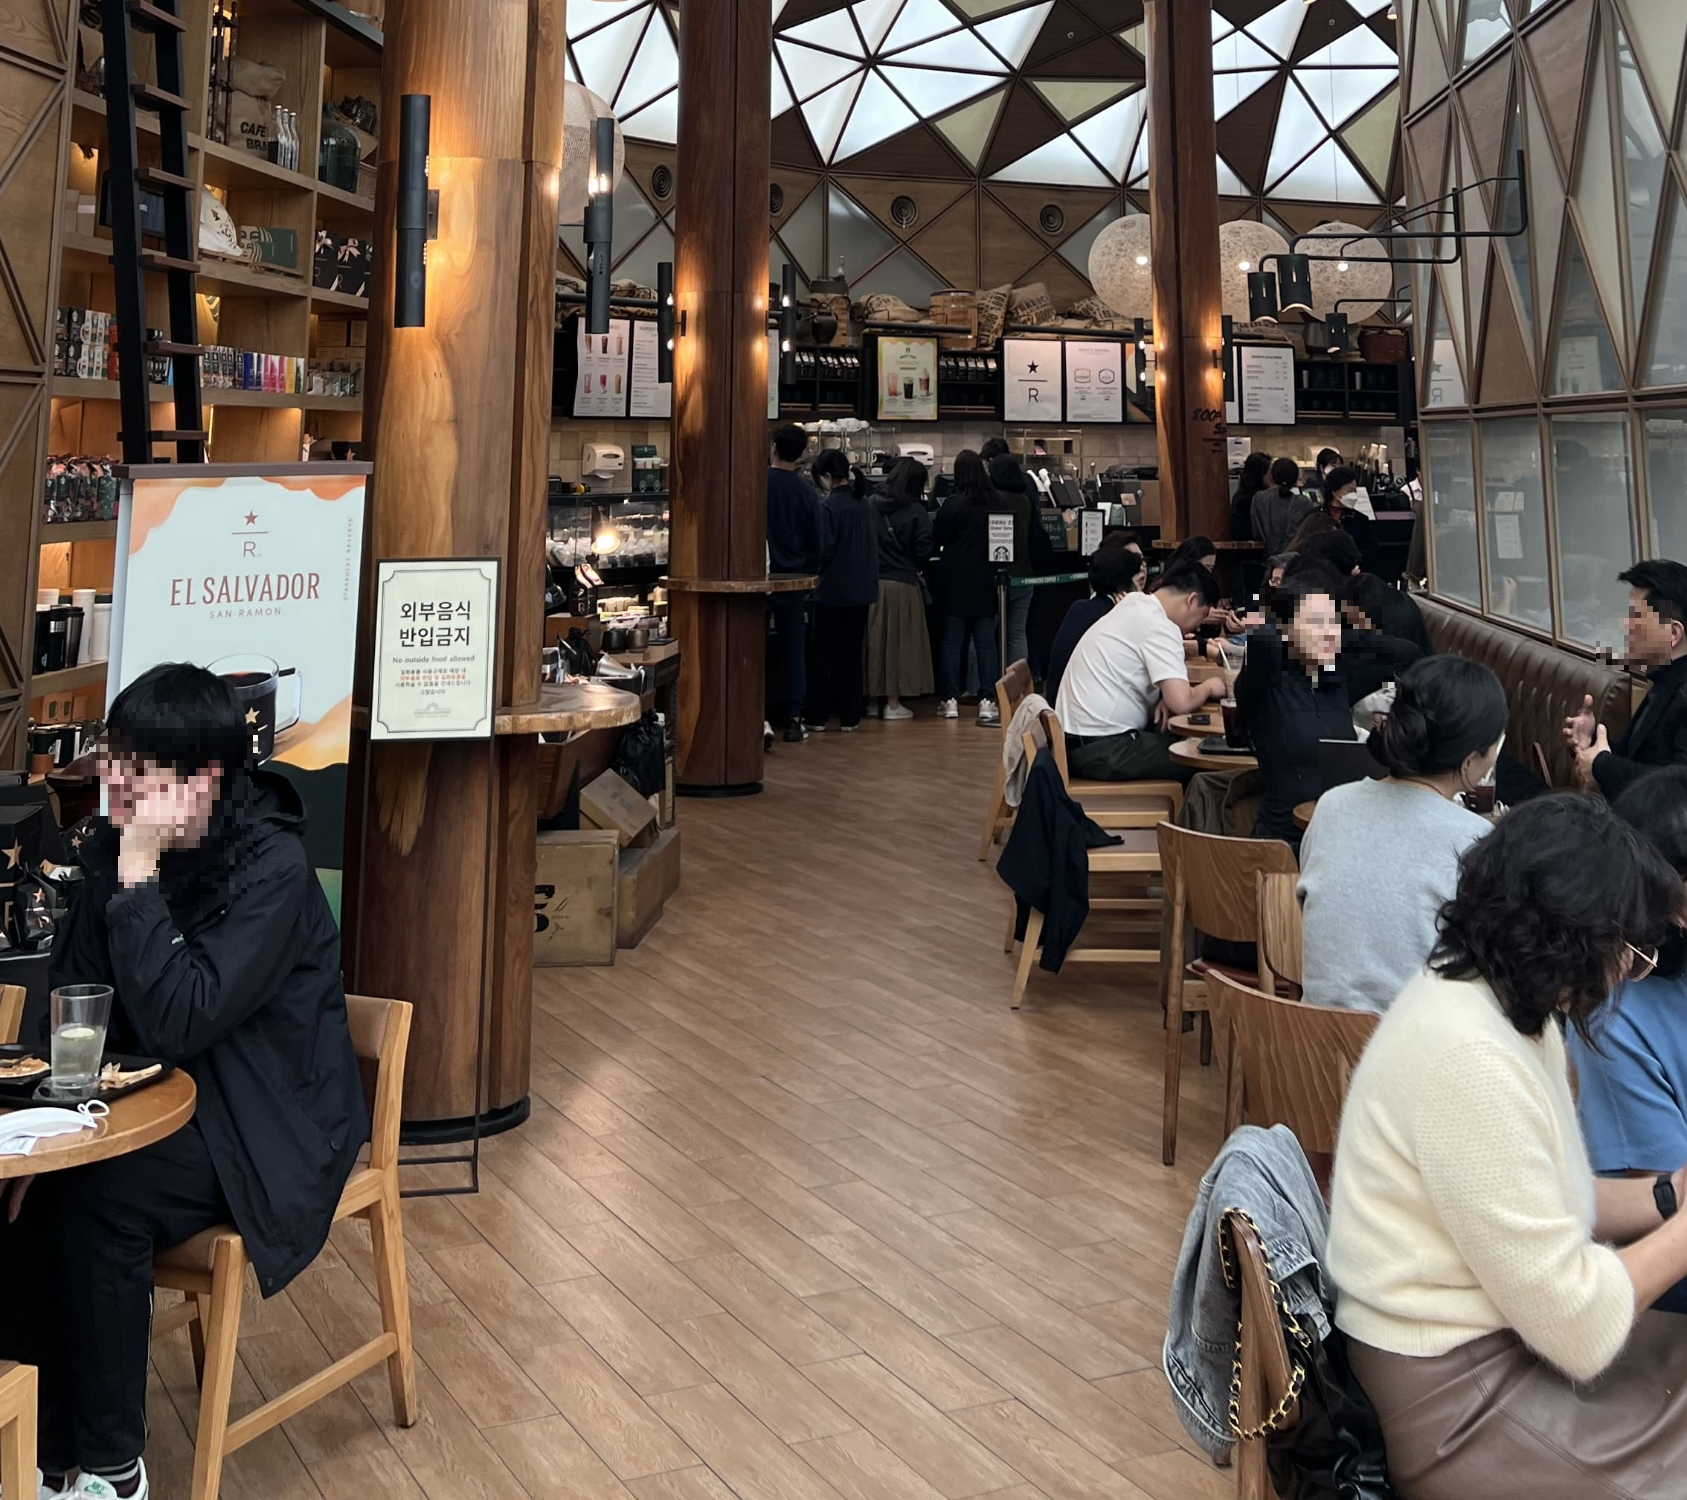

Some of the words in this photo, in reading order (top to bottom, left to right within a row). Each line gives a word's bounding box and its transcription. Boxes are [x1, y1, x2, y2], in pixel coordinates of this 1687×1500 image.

[1028, 387, 1039, 403] R
[243, 541, 256, 557] R
[170, 578, 196, 606] EL
[202, 573, 320, 605] SALVADOR
[209, 610, 232, 618] SAN
[238, 607, 281, 617] RAMON
[400, 600, 471, 621] 외부음식
[399, 626, 470, 647] 반입금지
